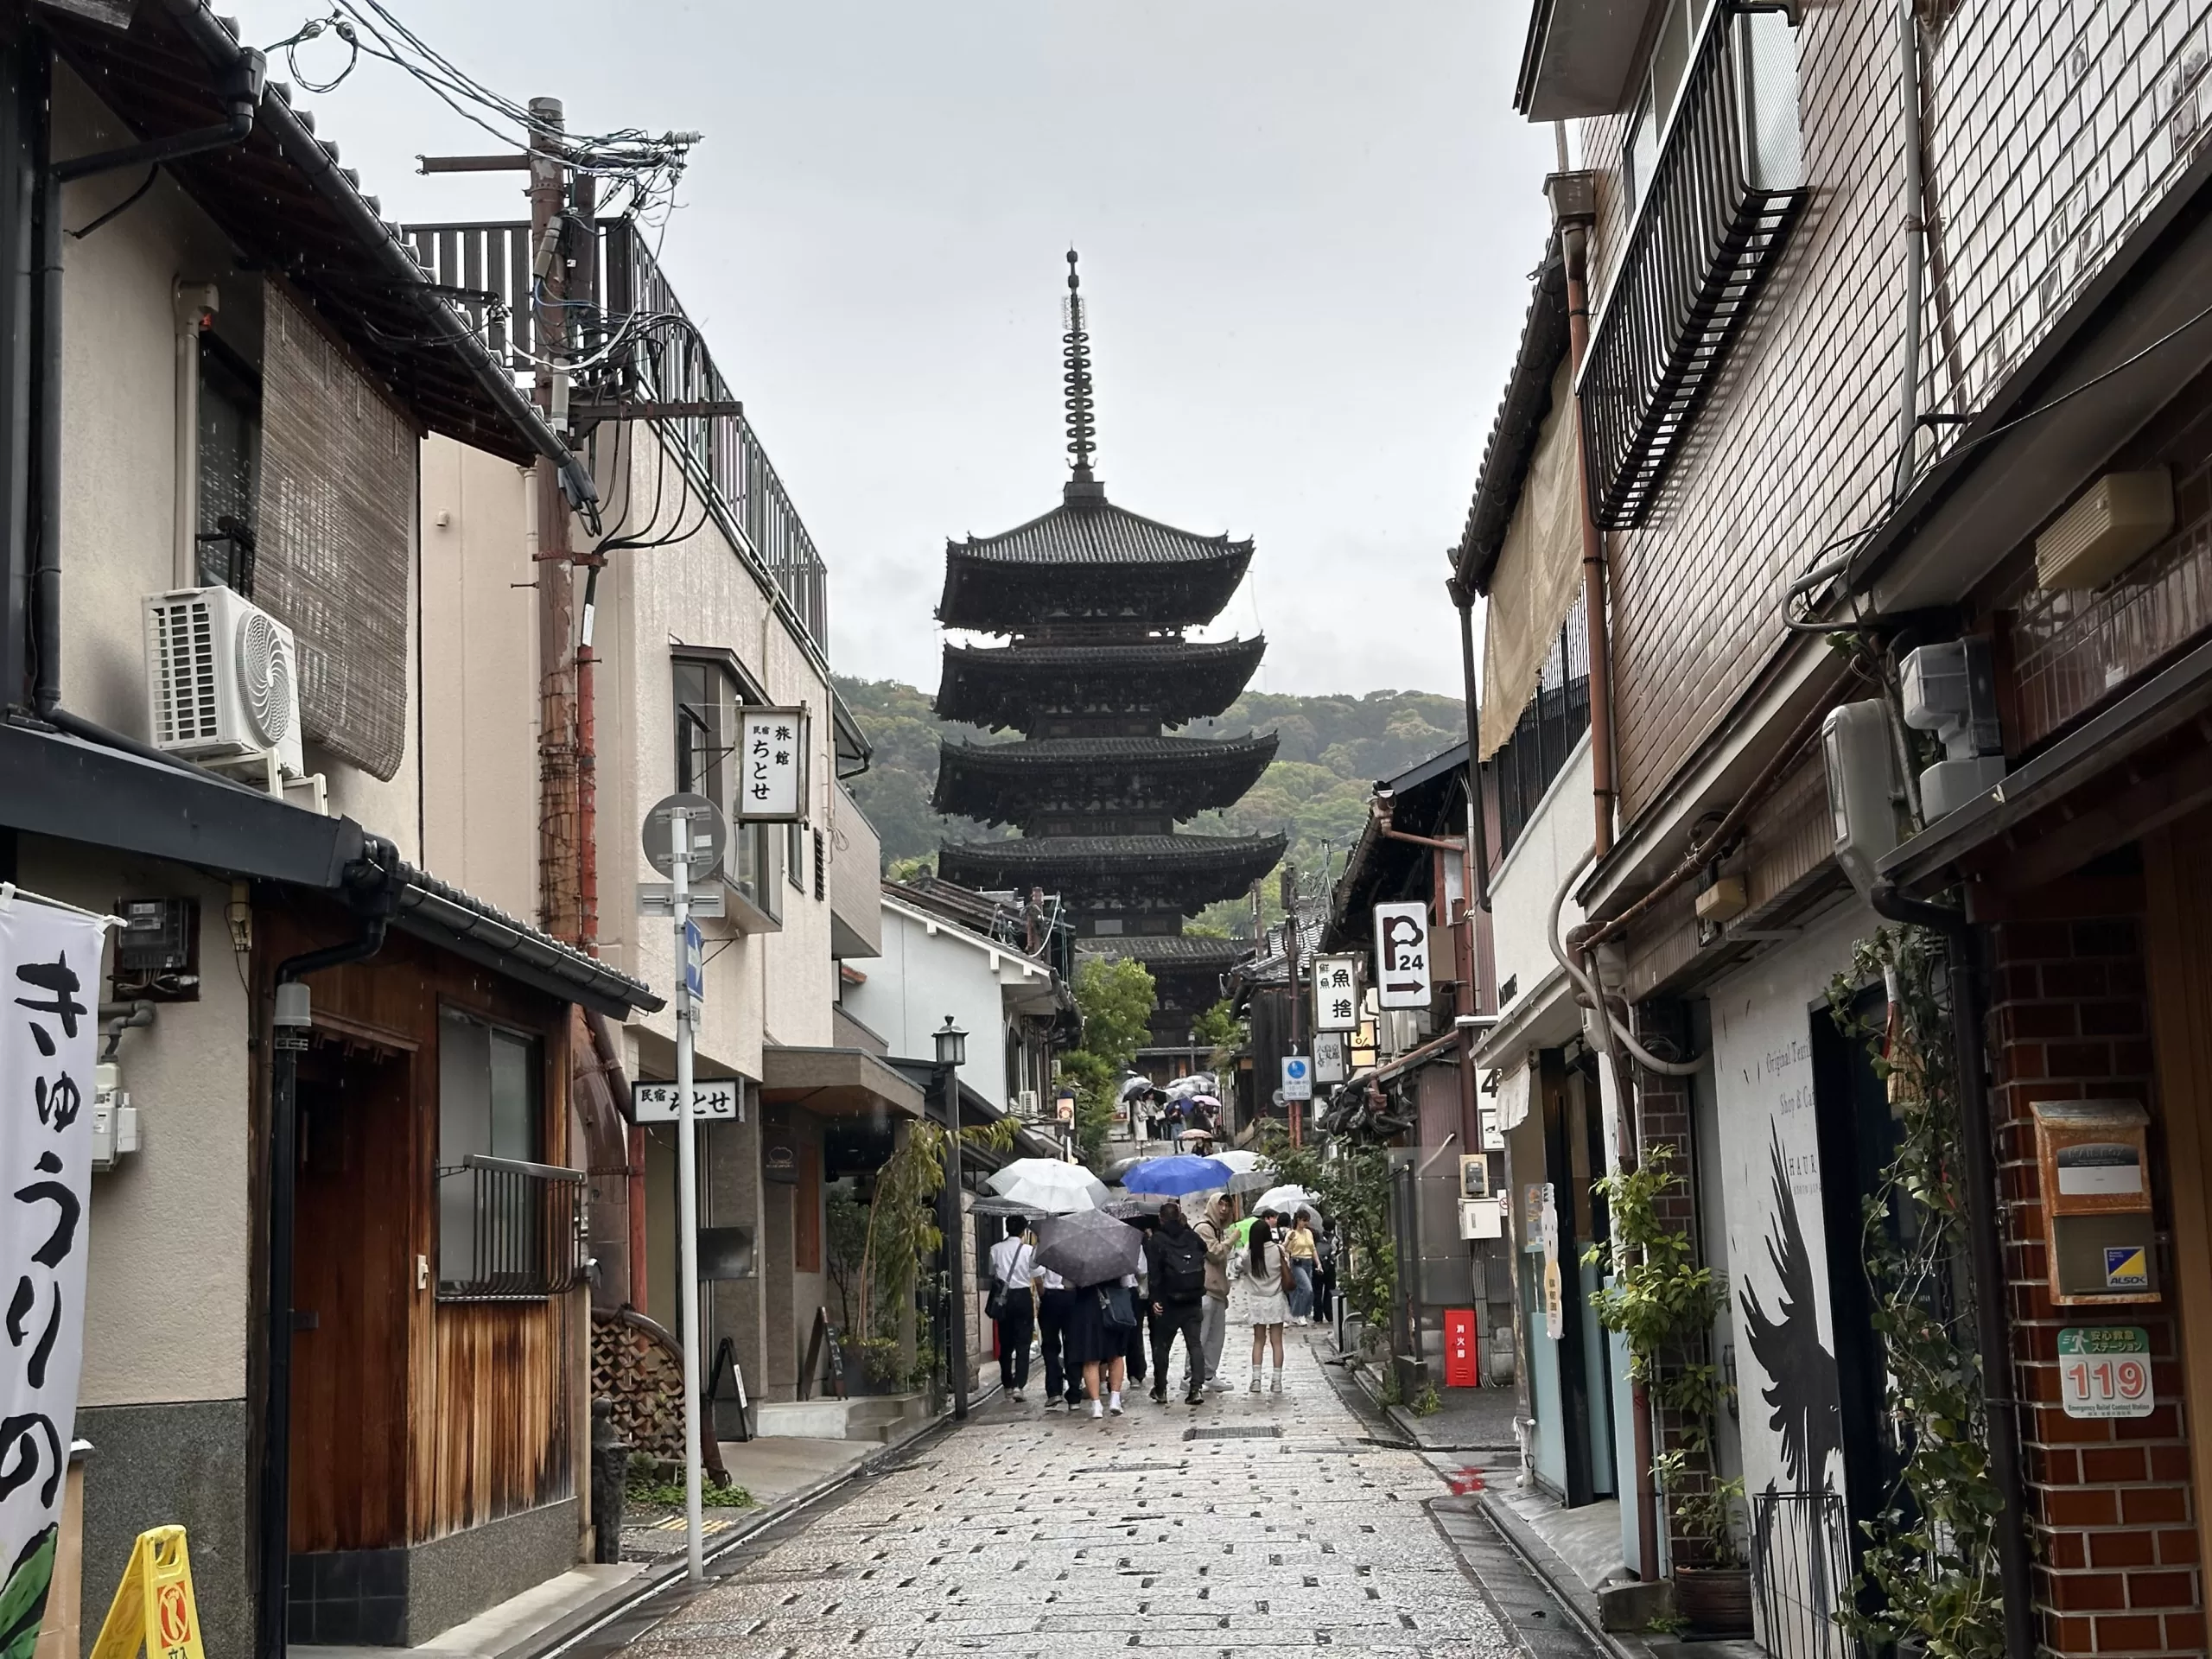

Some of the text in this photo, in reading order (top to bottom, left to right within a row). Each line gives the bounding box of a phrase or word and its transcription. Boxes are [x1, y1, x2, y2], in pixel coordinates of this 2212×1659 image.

[753, 726, 770, 734] 民宿
[775, 726, 791, 766] 旅館
[751, 740, 771, 800] ちとせ
[1399, 954, 1424, 971] 24
[1332, 969, 1352, 1018] 魚捨
[641, 1089, 666, 1102] 民宿
[0, 950, 88, 1510] きゅうりの
[2110, 1275, 2146, 1286] ALSOK
[2091, 1331, 2135, 1341] 安心救急
[2092, 1342, 2143, 1352] ステーション
[2067, 1360, 2147, 1400] 119
